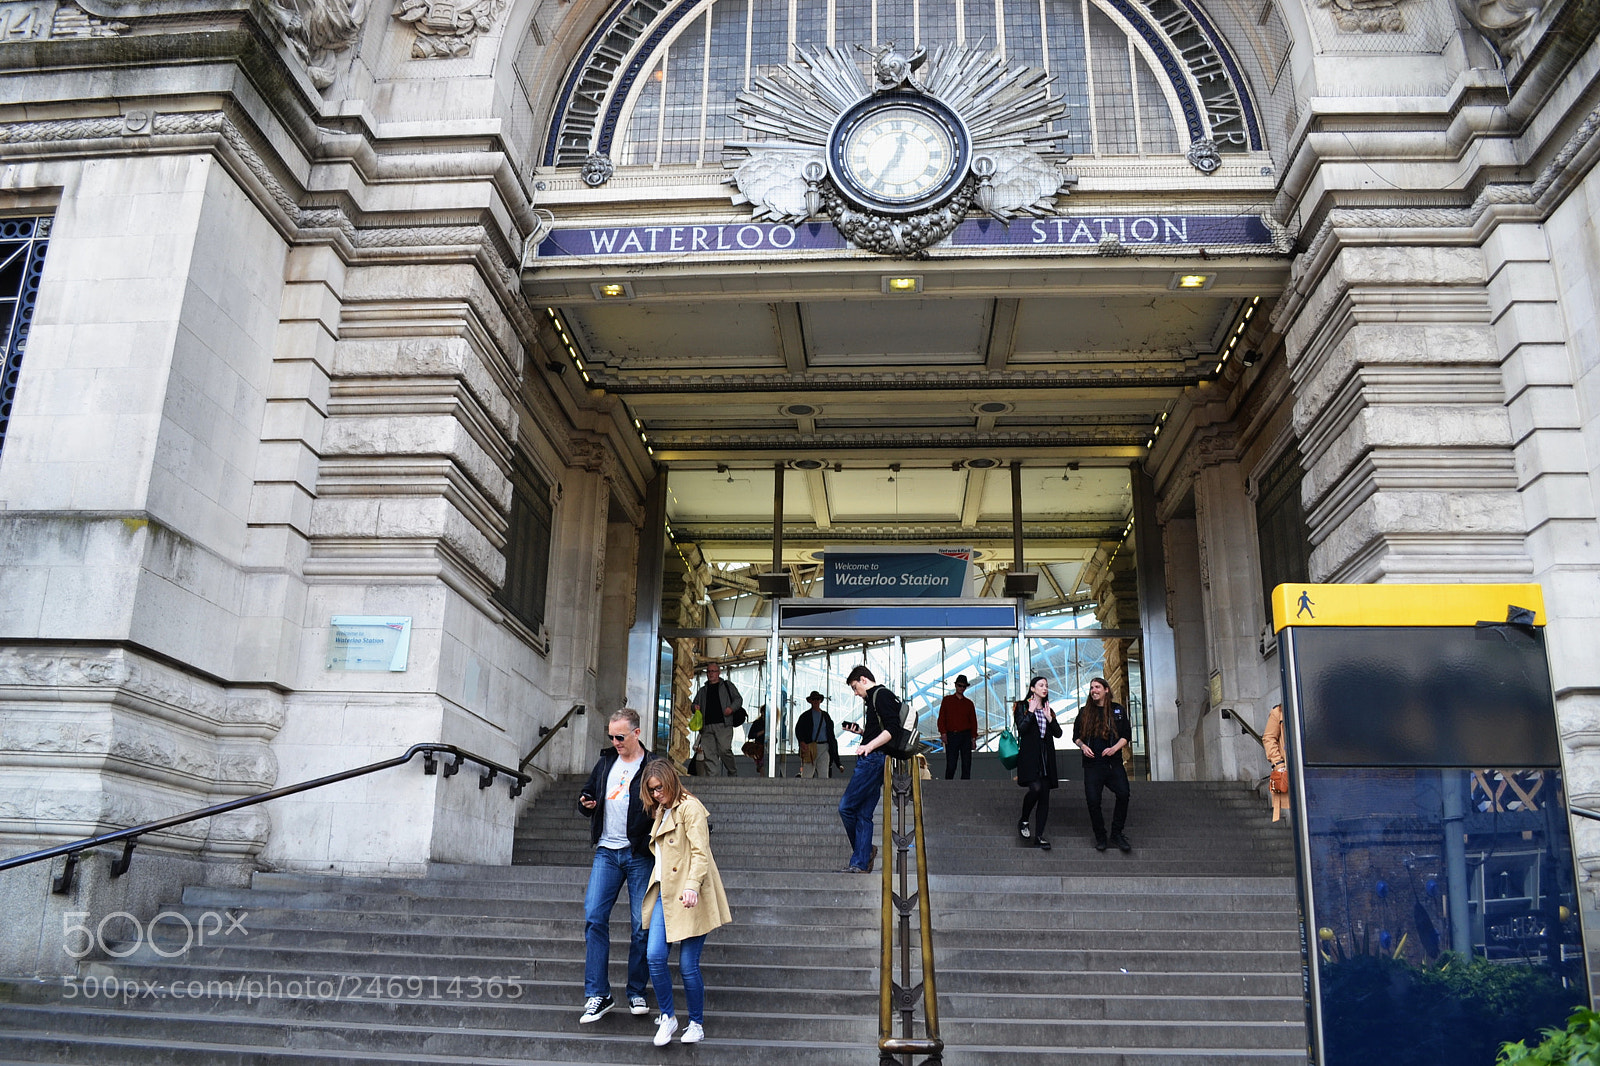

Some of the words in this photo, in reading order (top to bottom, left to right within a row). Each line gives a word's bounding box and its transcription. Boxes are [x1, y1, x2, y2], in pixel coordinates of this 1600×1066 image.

[0, 7, 42, 39] 14
[556, 45, 626, 167] DEDICATED
[607, 14, 647, 41] TO
[1156, 10, 1198, 37] IN
[1177, 34, 1227, 86] THE
[1203, 91, 1246, 145] WAR
[590, 224, 796, 253] WATERLOO
[1031, 217, 1188, 243] STATION
[835, 562, 869, 570] Welcome
[871, 562, 879, 570] to
[835, 573, 897, 586] Waterloo
[900, 573, 949, 586] Station
